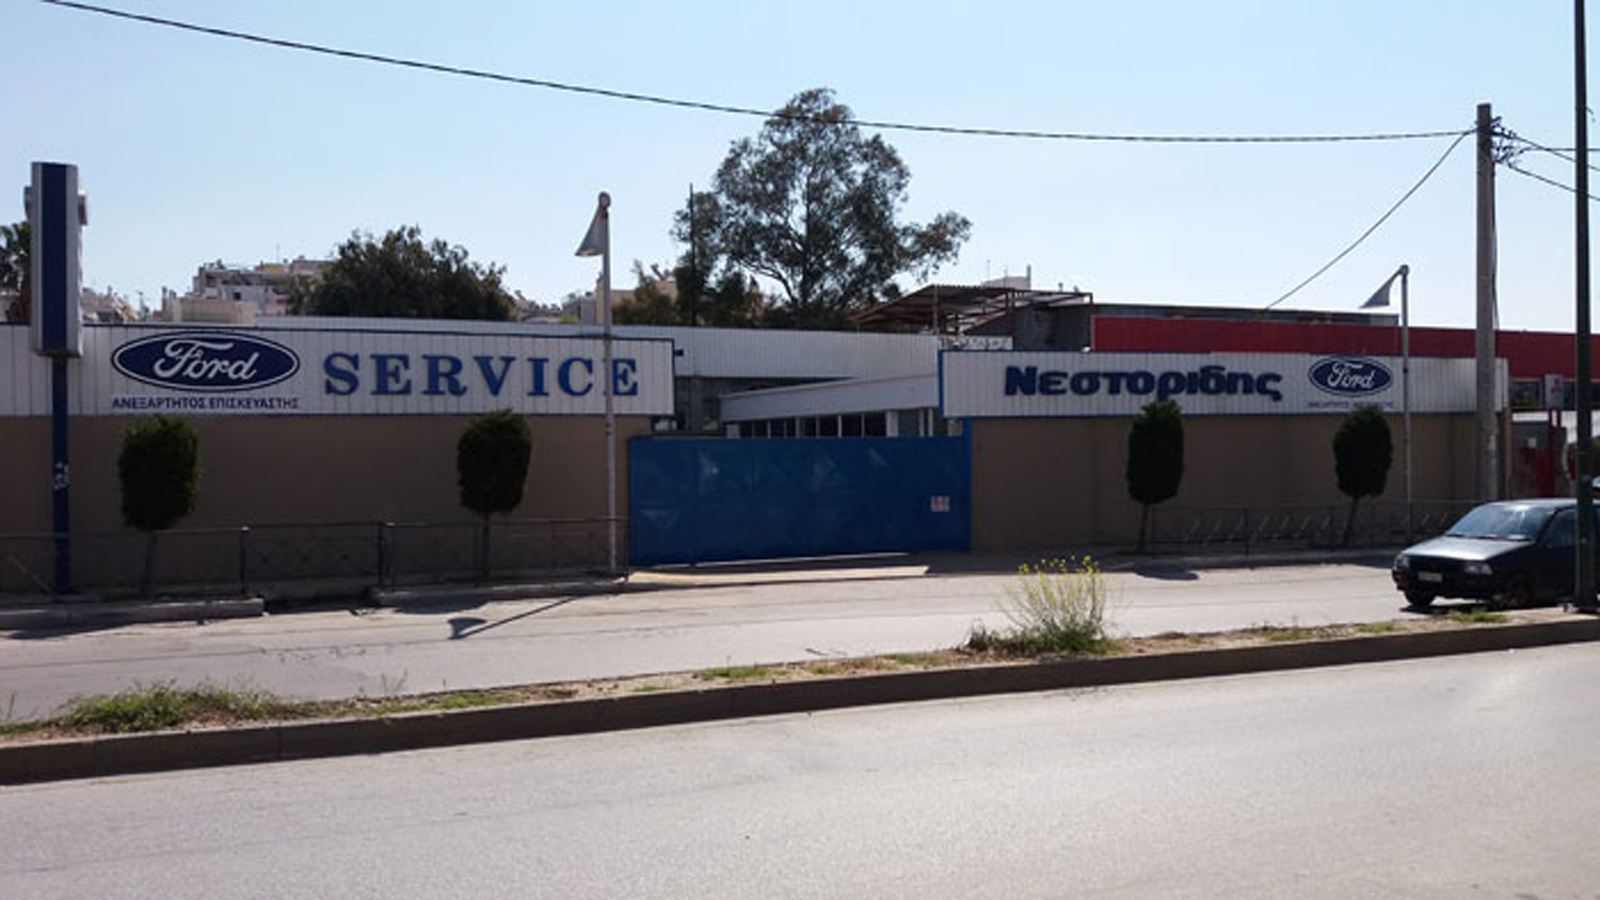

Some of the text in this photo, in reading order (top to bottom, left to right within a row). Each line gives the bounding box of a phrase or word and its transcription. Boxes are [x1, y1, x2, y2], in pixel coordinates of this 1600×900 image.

[153, 339, 260, 379] Ford
[323, 352, 638, 397] SERVICE
[1327, 361, 1376, 389] Ford
[1004, 365, 1283, 402] Νεστοριδης
[111, 397, 299, 409] ΑΝΕΞΑΡΤΗΤΟΣ ΕΠΙΣΚΕΥΑΣΤΗΣ
